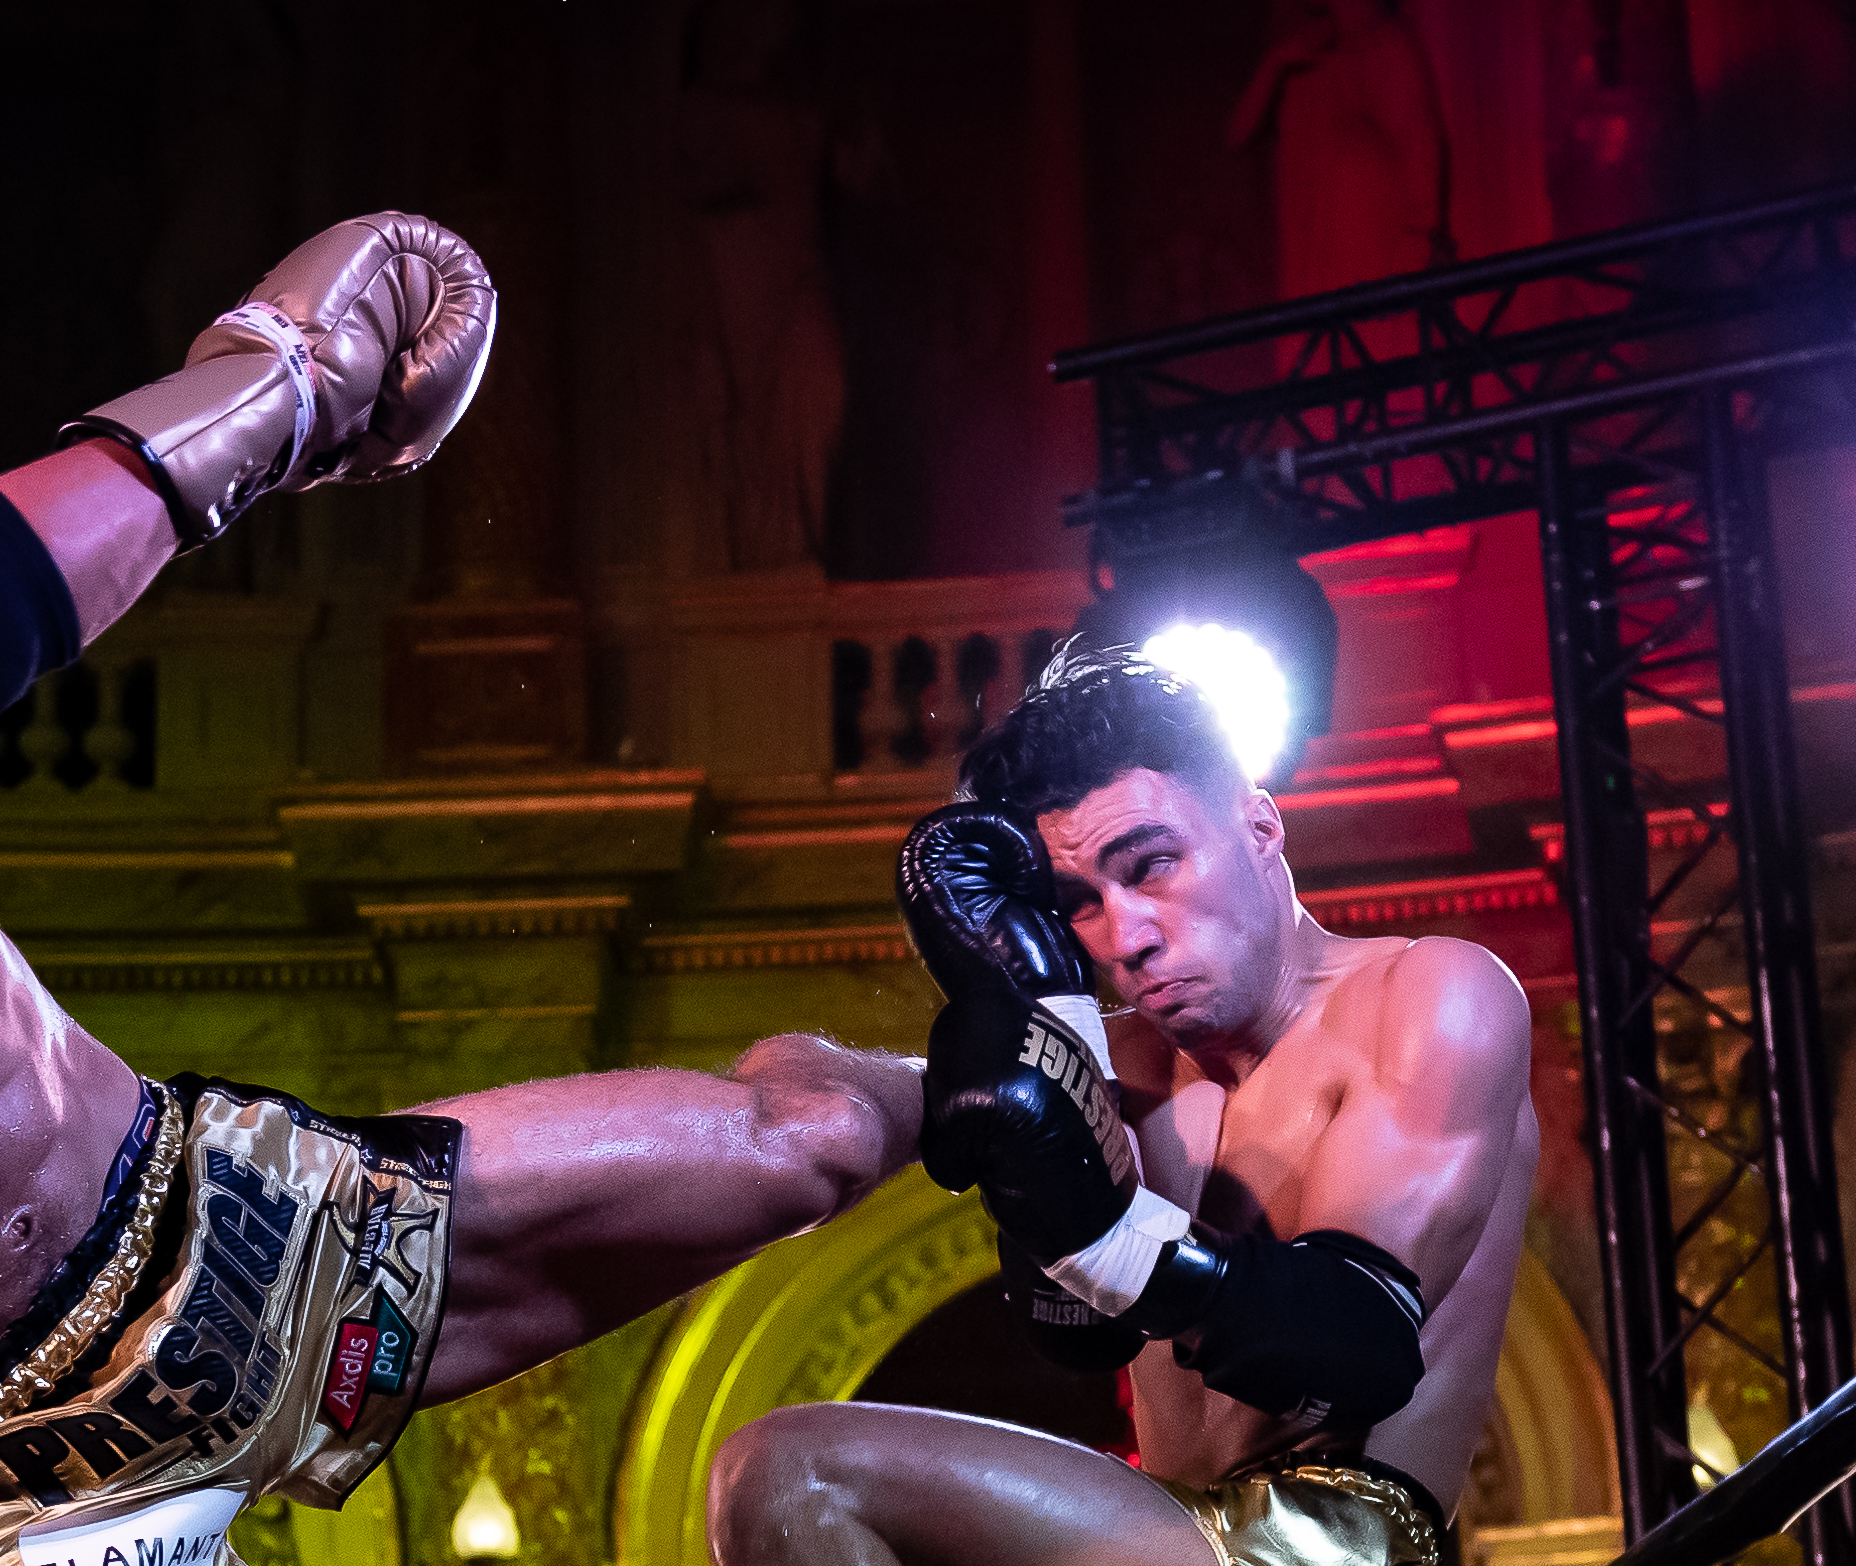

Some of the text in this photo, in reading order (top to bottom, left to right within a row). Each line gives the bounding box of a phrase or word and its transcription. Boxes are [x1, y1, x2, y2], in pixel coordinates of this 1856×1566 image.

[330, 1337, 369, 1409] Axdis
[373, 1331, 400, 1377] pro
[187, 1332, 284, 1458] FIGHT
